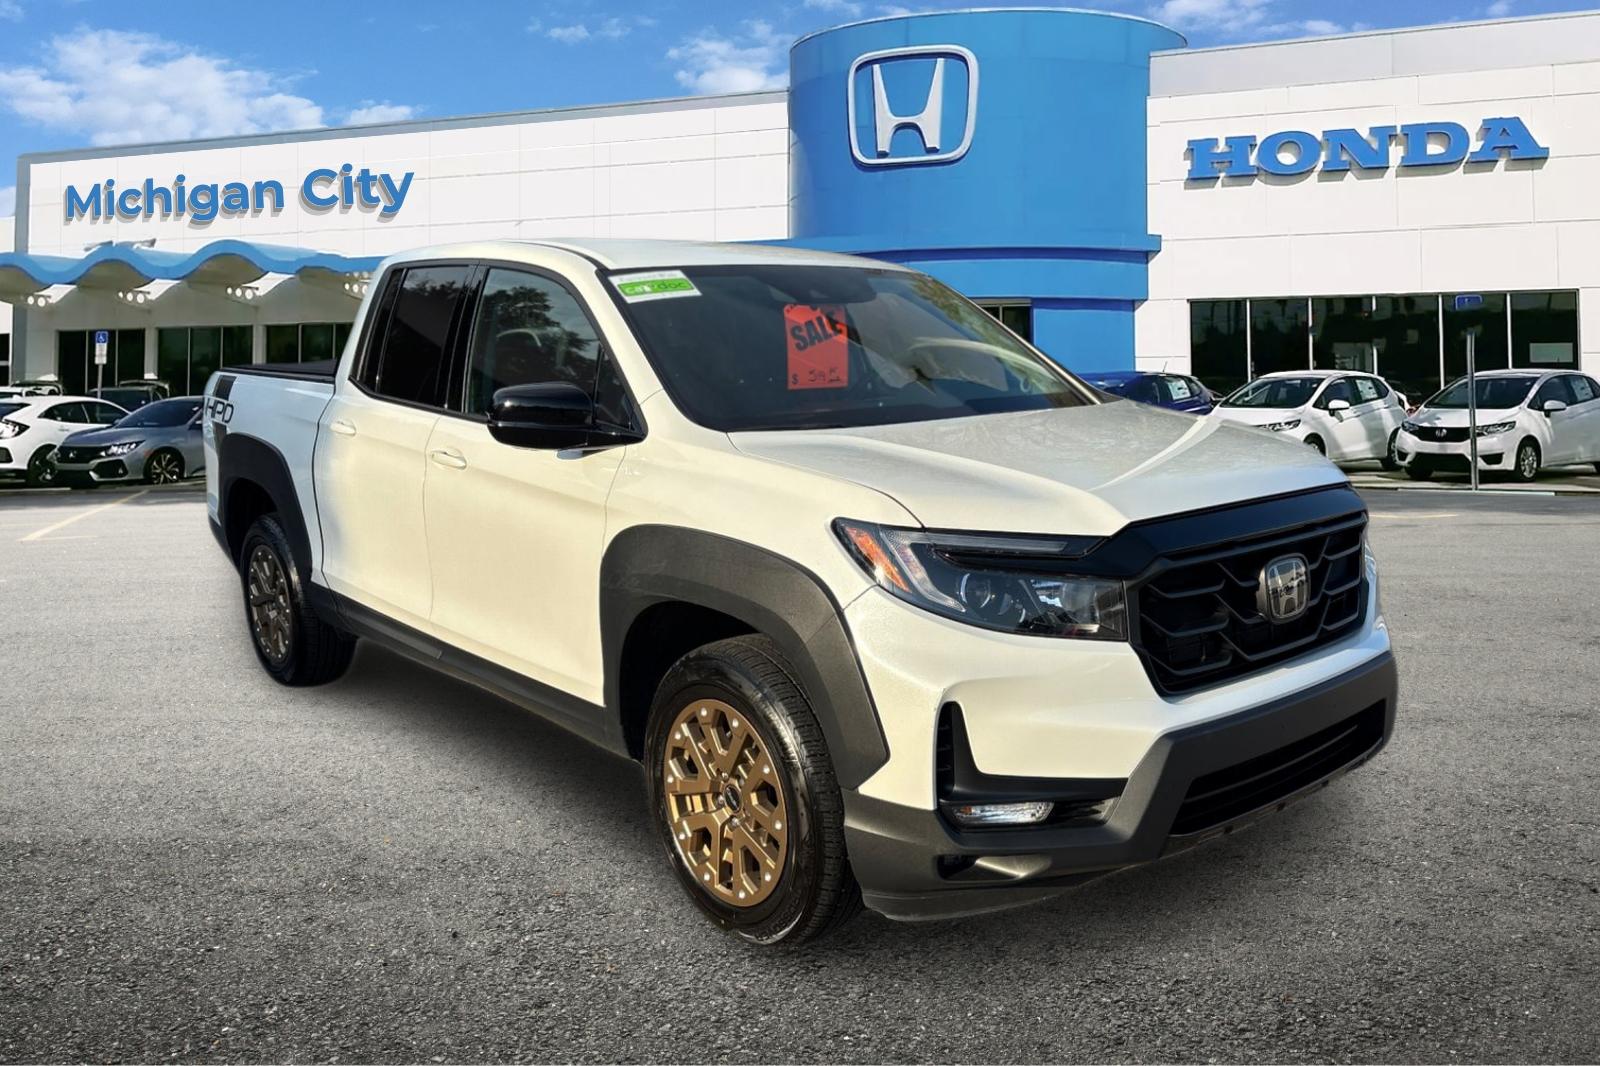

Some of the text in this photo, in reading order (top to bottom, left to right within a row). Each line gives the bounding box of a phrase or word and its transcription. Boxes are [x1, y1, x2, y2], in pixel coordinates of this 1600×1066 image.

[1186, 116, 1550, 182] HONDA
[65, 162, 415, 223] Michigan City
[790, 311, 844, 352] SALE
[205, 397, 234, 424] HPD
